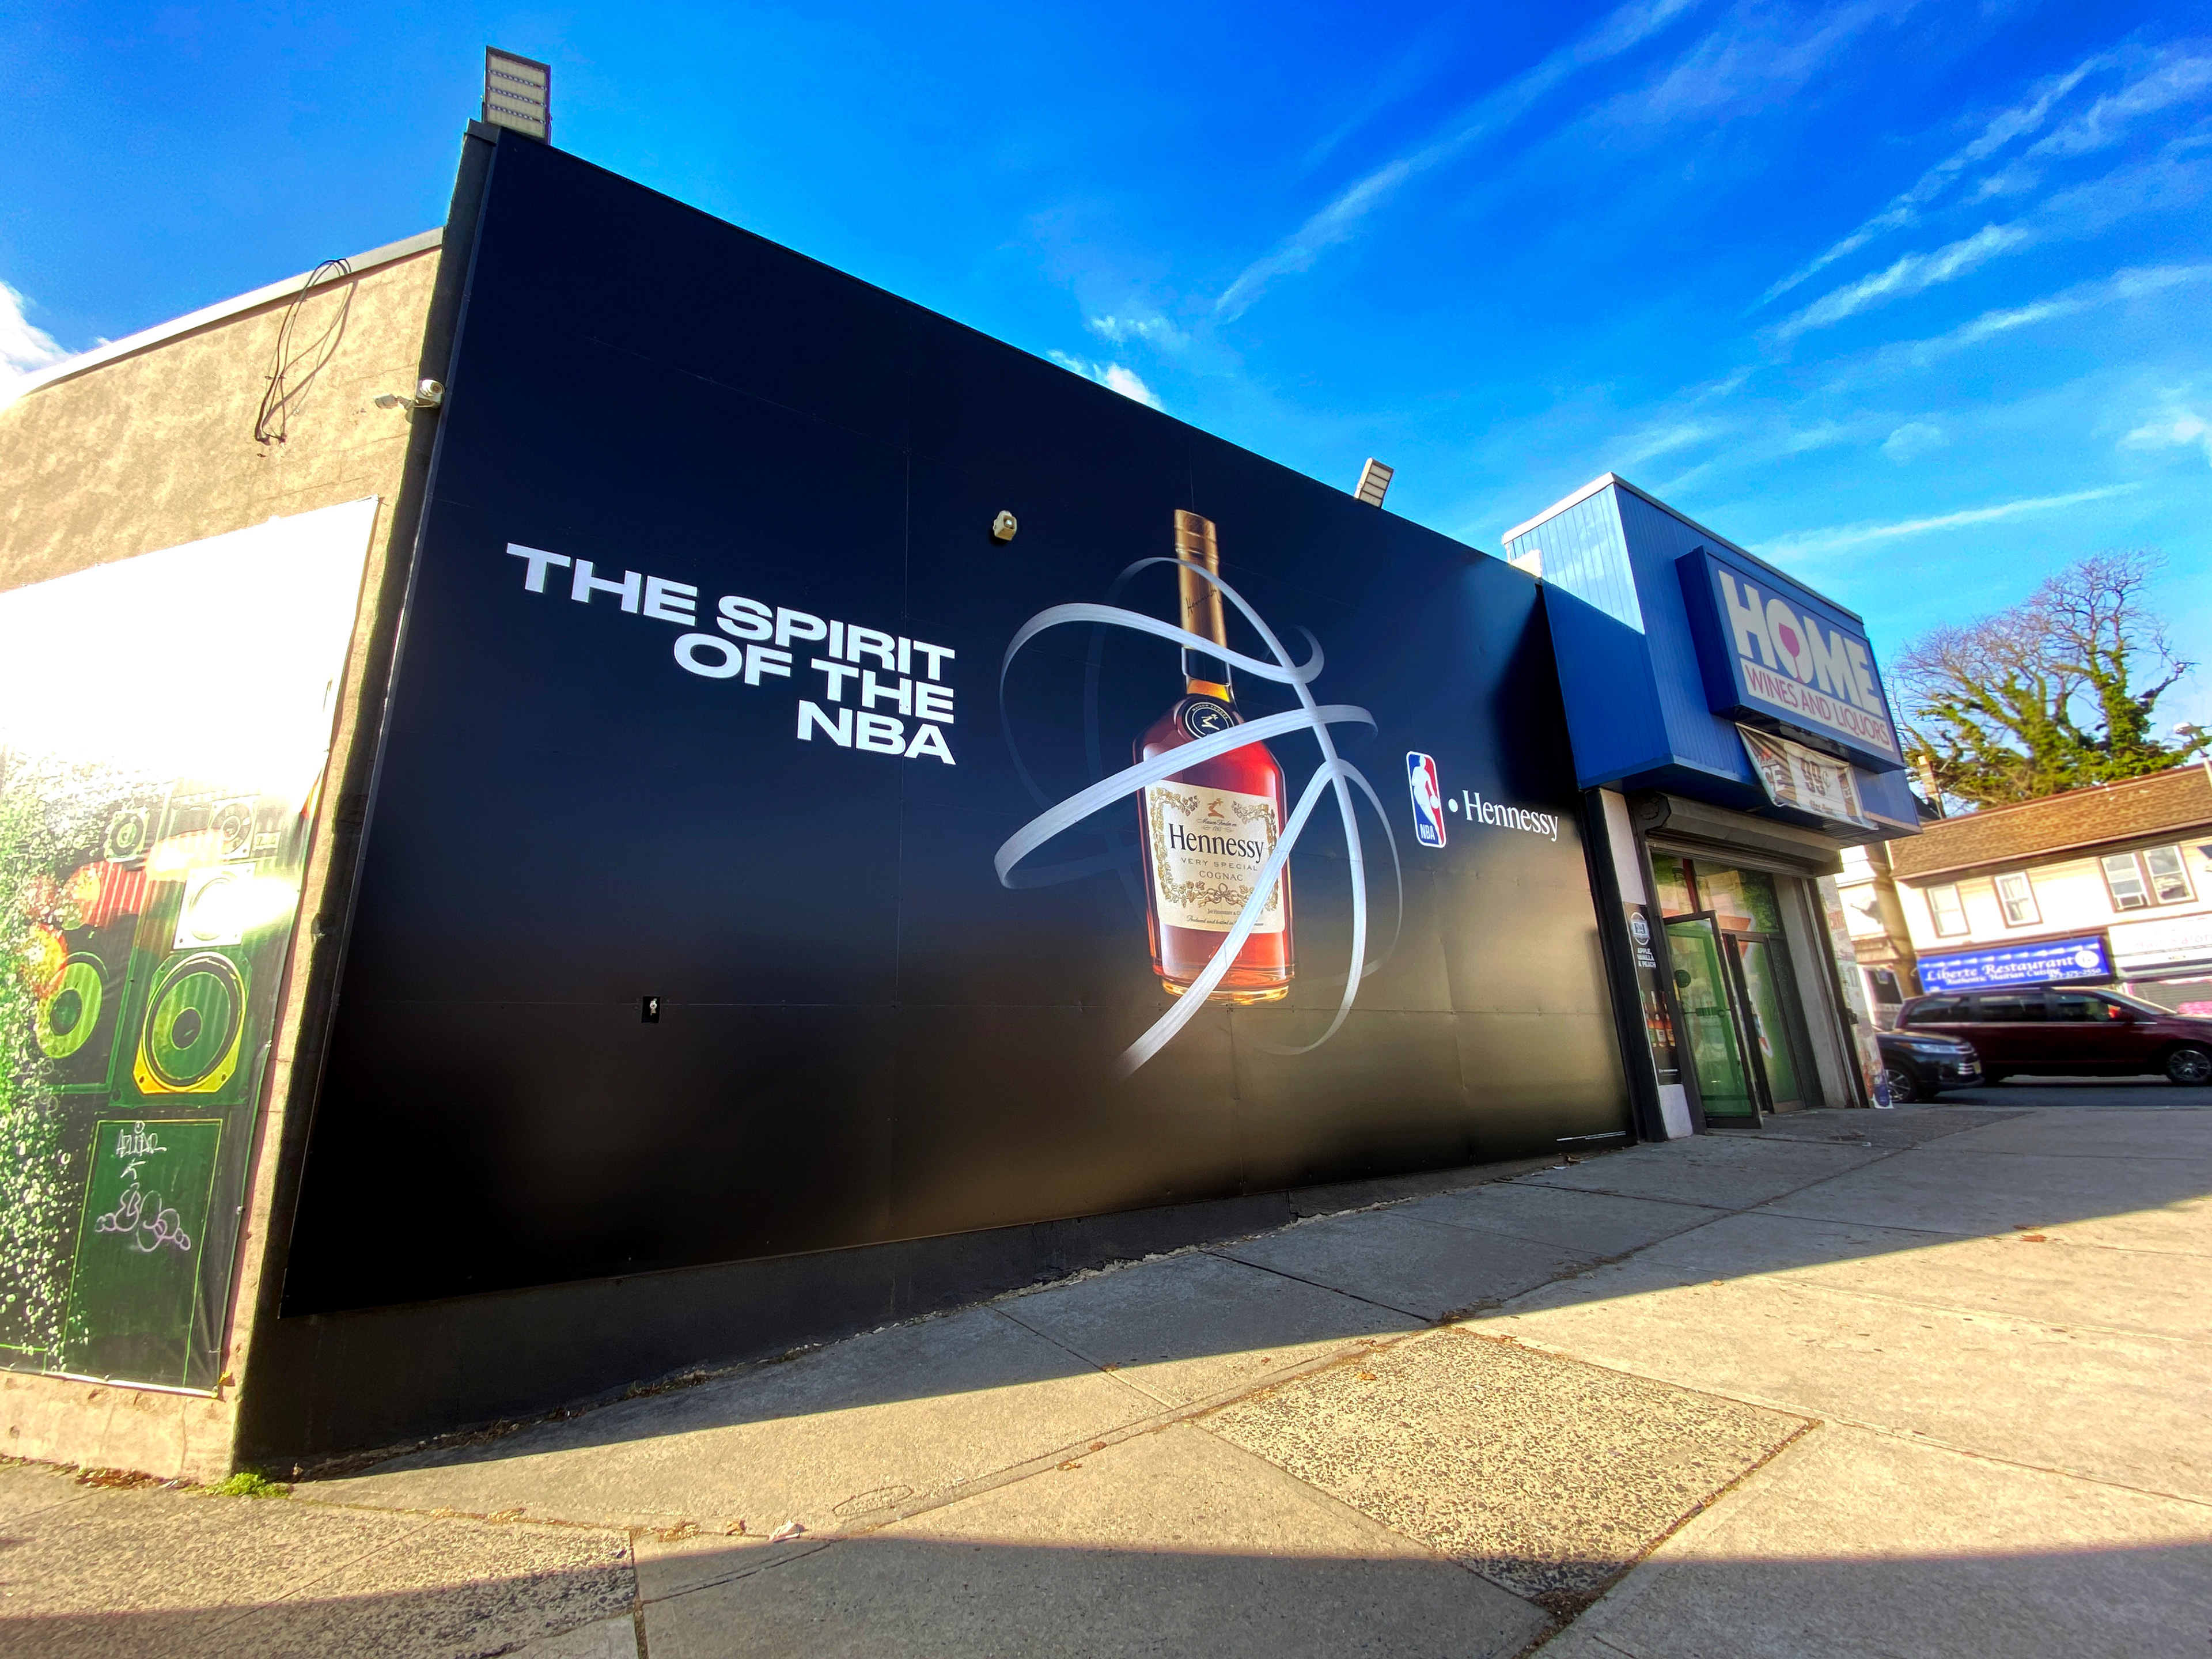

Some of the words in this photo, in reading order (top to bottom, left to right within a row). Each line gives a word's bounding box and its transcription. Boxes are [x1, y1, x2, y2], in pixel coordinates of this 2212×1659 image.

[506, 542, 698, 627] THE
[716, 595, 956, 681] SPIRIT
[1718, 569, 1884, 718] HOME
[673, 632, 793, 687] OF
[811, 657, 955, 724] THE
[1744, 664, 1798, 708] WINES
[1801, 688, 1832, 721] AND
[1832, 702, 1890, 745] LIQUORS
[797, 699, 957, 765] NBA
[1419, 823, 1435, 840] NBA
[1462, 789, 1558, 842] Hennessy
[1169, 823, 1264, 863] Hennessy
[1181, 857, 1209, 865] VERY
[1214, 861, 1258, 871] SPECIAL
[1199, 870, 1244, 881] COGNAC
[1981, 956, 2074, 975] Restaurant
